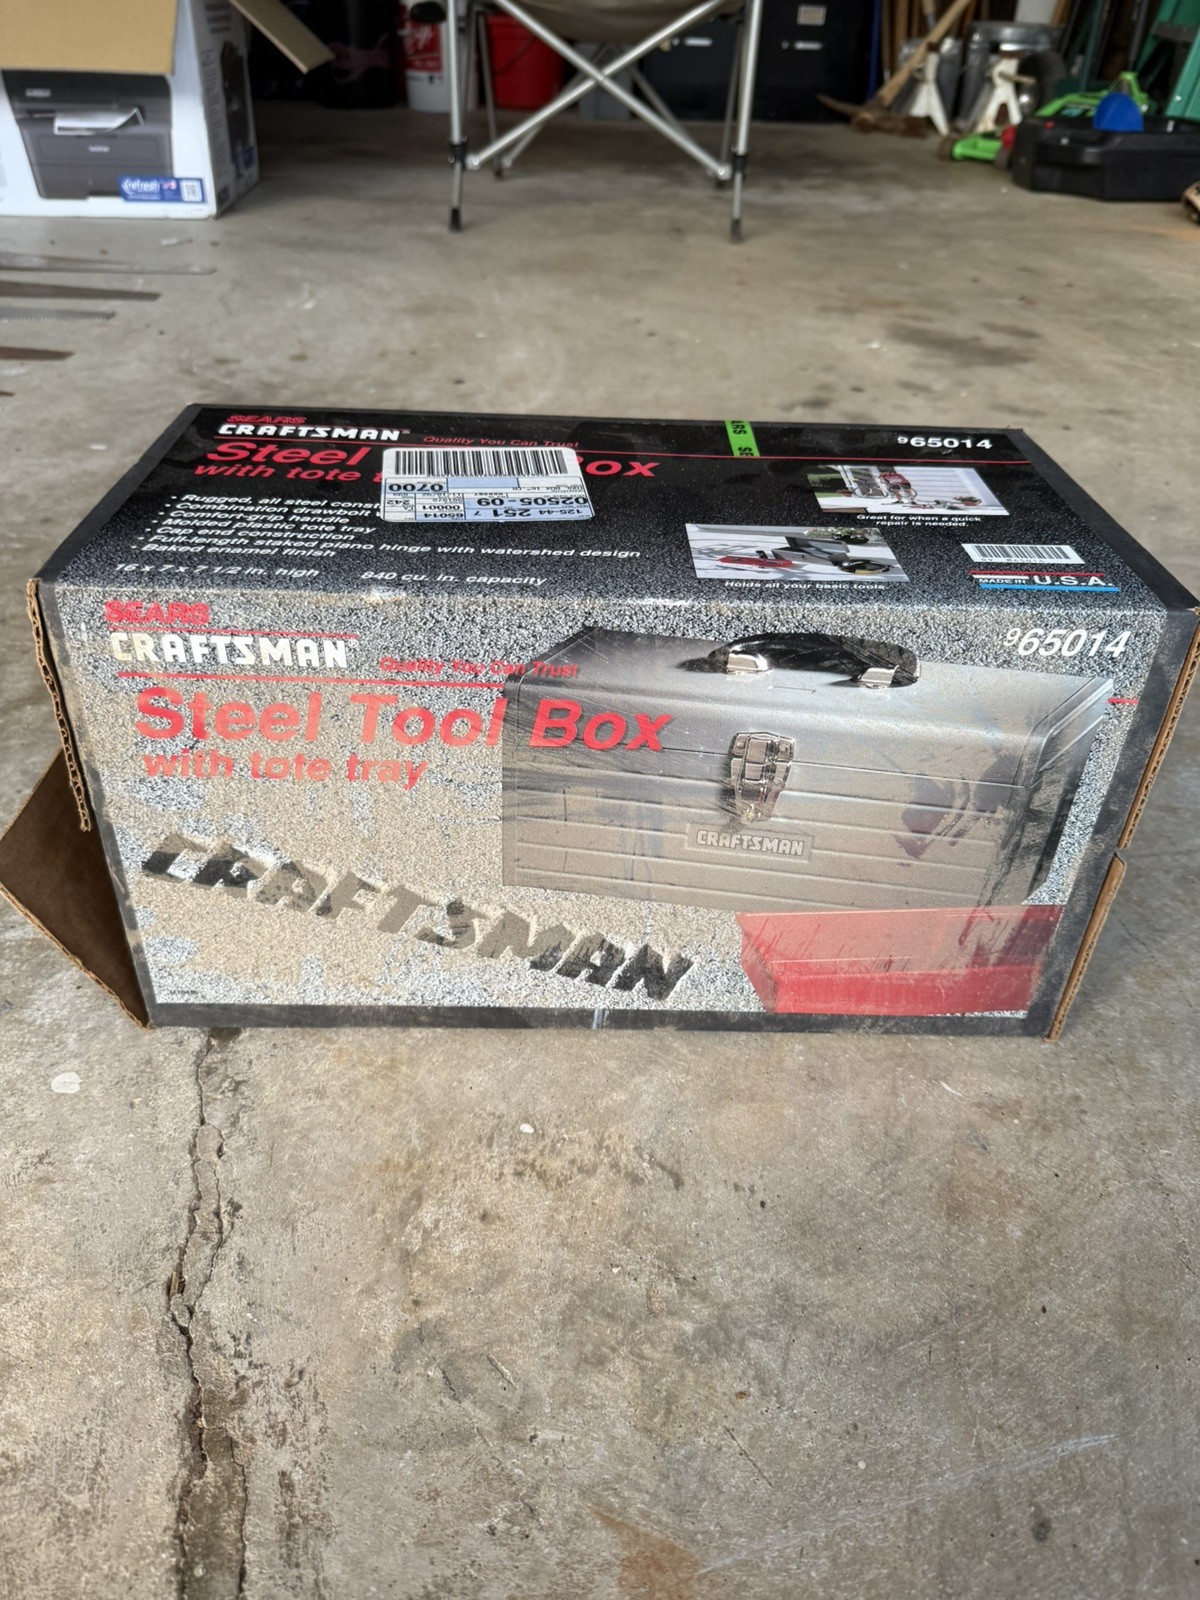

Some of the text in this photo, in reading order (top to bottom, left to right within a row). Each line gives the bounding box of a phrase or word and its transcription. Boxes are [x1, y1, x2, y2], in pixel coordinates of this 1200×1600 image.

[227, 415, 307, 424] SEARS
[423, 436, 579, 448] Quality You Can Trust
[897, 436, 993, 449] 965014
[206, 442, 661, 477] Steel ox
[194, 464, 275, 478] with
[286, 467, 362, 482] tote
[388, 483, 444, 492] 0700
[181, 494, 253, 504] Rugged,
[170, 510, 350, 523] Comfort-grip handle
[176, 502, 289, 513] Combination
[293, 507, 371, 516] drawbolt
[156, 526, 194, 535] Cap
[237, 531, 355, 540] construction
[162, 518, 377, 534] Molded plastic tote tray
[141, 543, 336, 557] Baked enamel finish
[148, 535, 249, 545] Full-length
[253, 539, 319, 547] staked
[379, 543, 432, 553] hinge
[436, 546, 475, 554] with
[480, 547, 575, 557] watershed
[579, 549, 641, 559] design
[115, 563, 139, 571] 16
[159, 564, 175, 572] 7
[194, 565, 209, 573] 7
[212, 566, 243, 574] 1/2
[244, 567, 268, 575] in.
[275, 568, 320, 578] high
[361, 571, 548, 586] 840 cu. in. capacity
[1033, 575, 1114, 586] U.S.A.
[104, 601, 211, 625] SEARS
[1003, 627, 1132, 658] 965014
[378, 657, 581, 678] Quality You Can Trust
[134, 686, 674, 751] Steel Tool Box
[142, 747, 428, 791] with tote tray
[696, 829, 805, 857] CRAFTSMAN
[141, 832, 697, 1001] CRAFTSMAN
